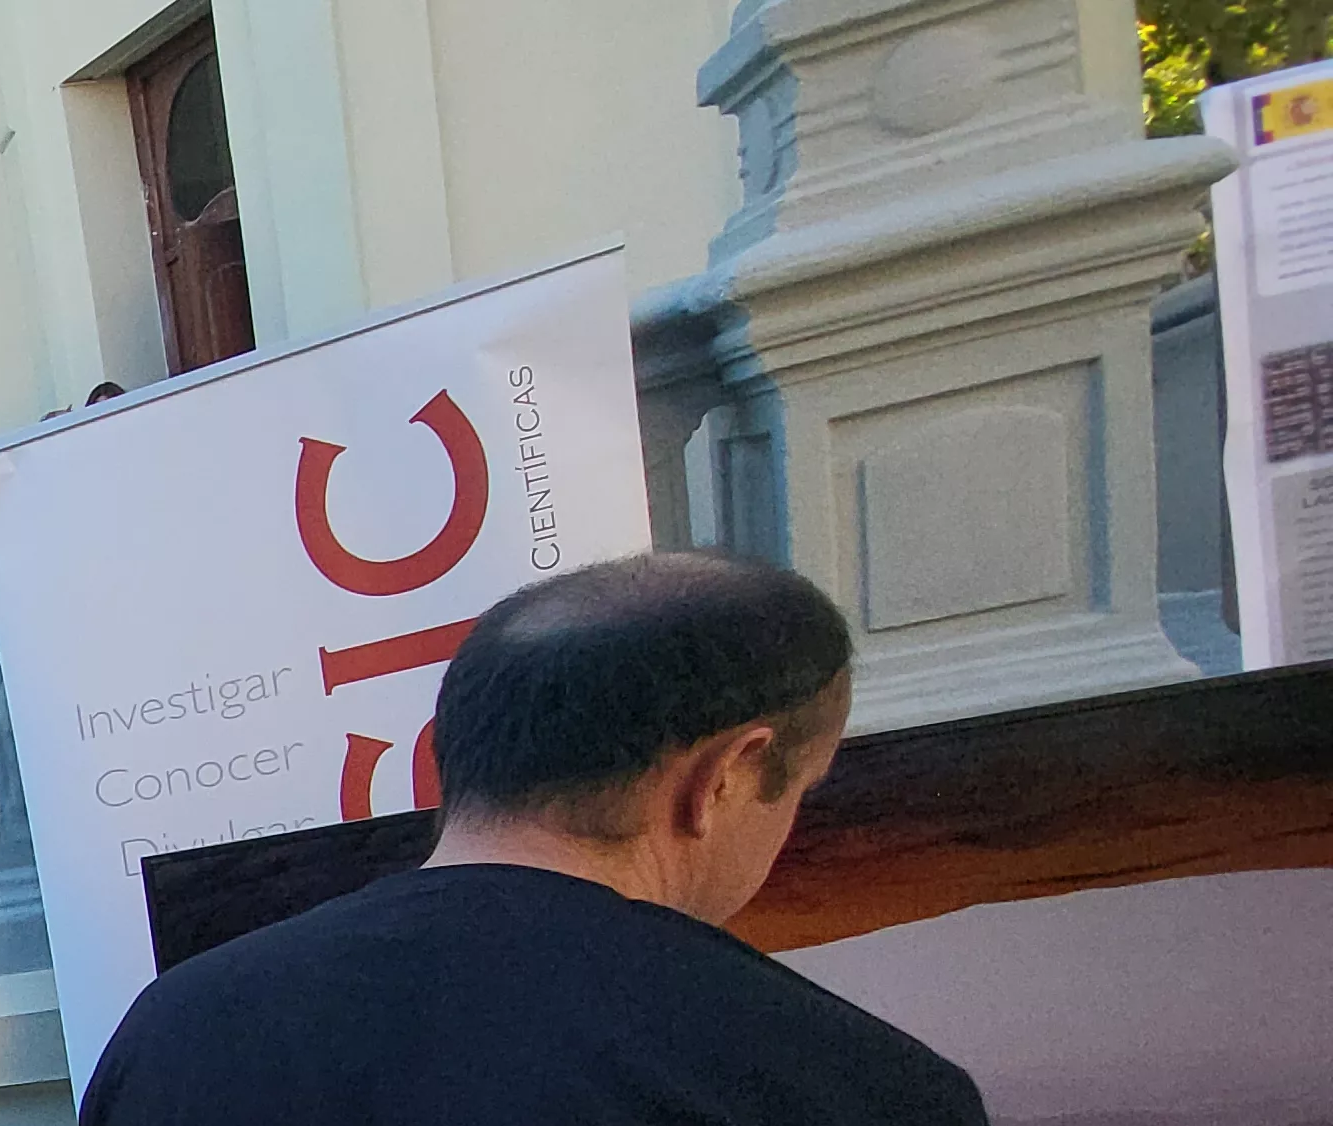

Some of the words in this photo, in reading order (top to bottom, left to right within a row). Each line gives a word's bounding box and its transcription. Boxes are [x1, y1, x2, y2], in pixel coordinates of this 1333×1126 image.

[509, 365, 561, 571] CIENTÍFICAS
[76, 667, 292, 741] Investigar
[95, 742, 304, 807] Conocer
